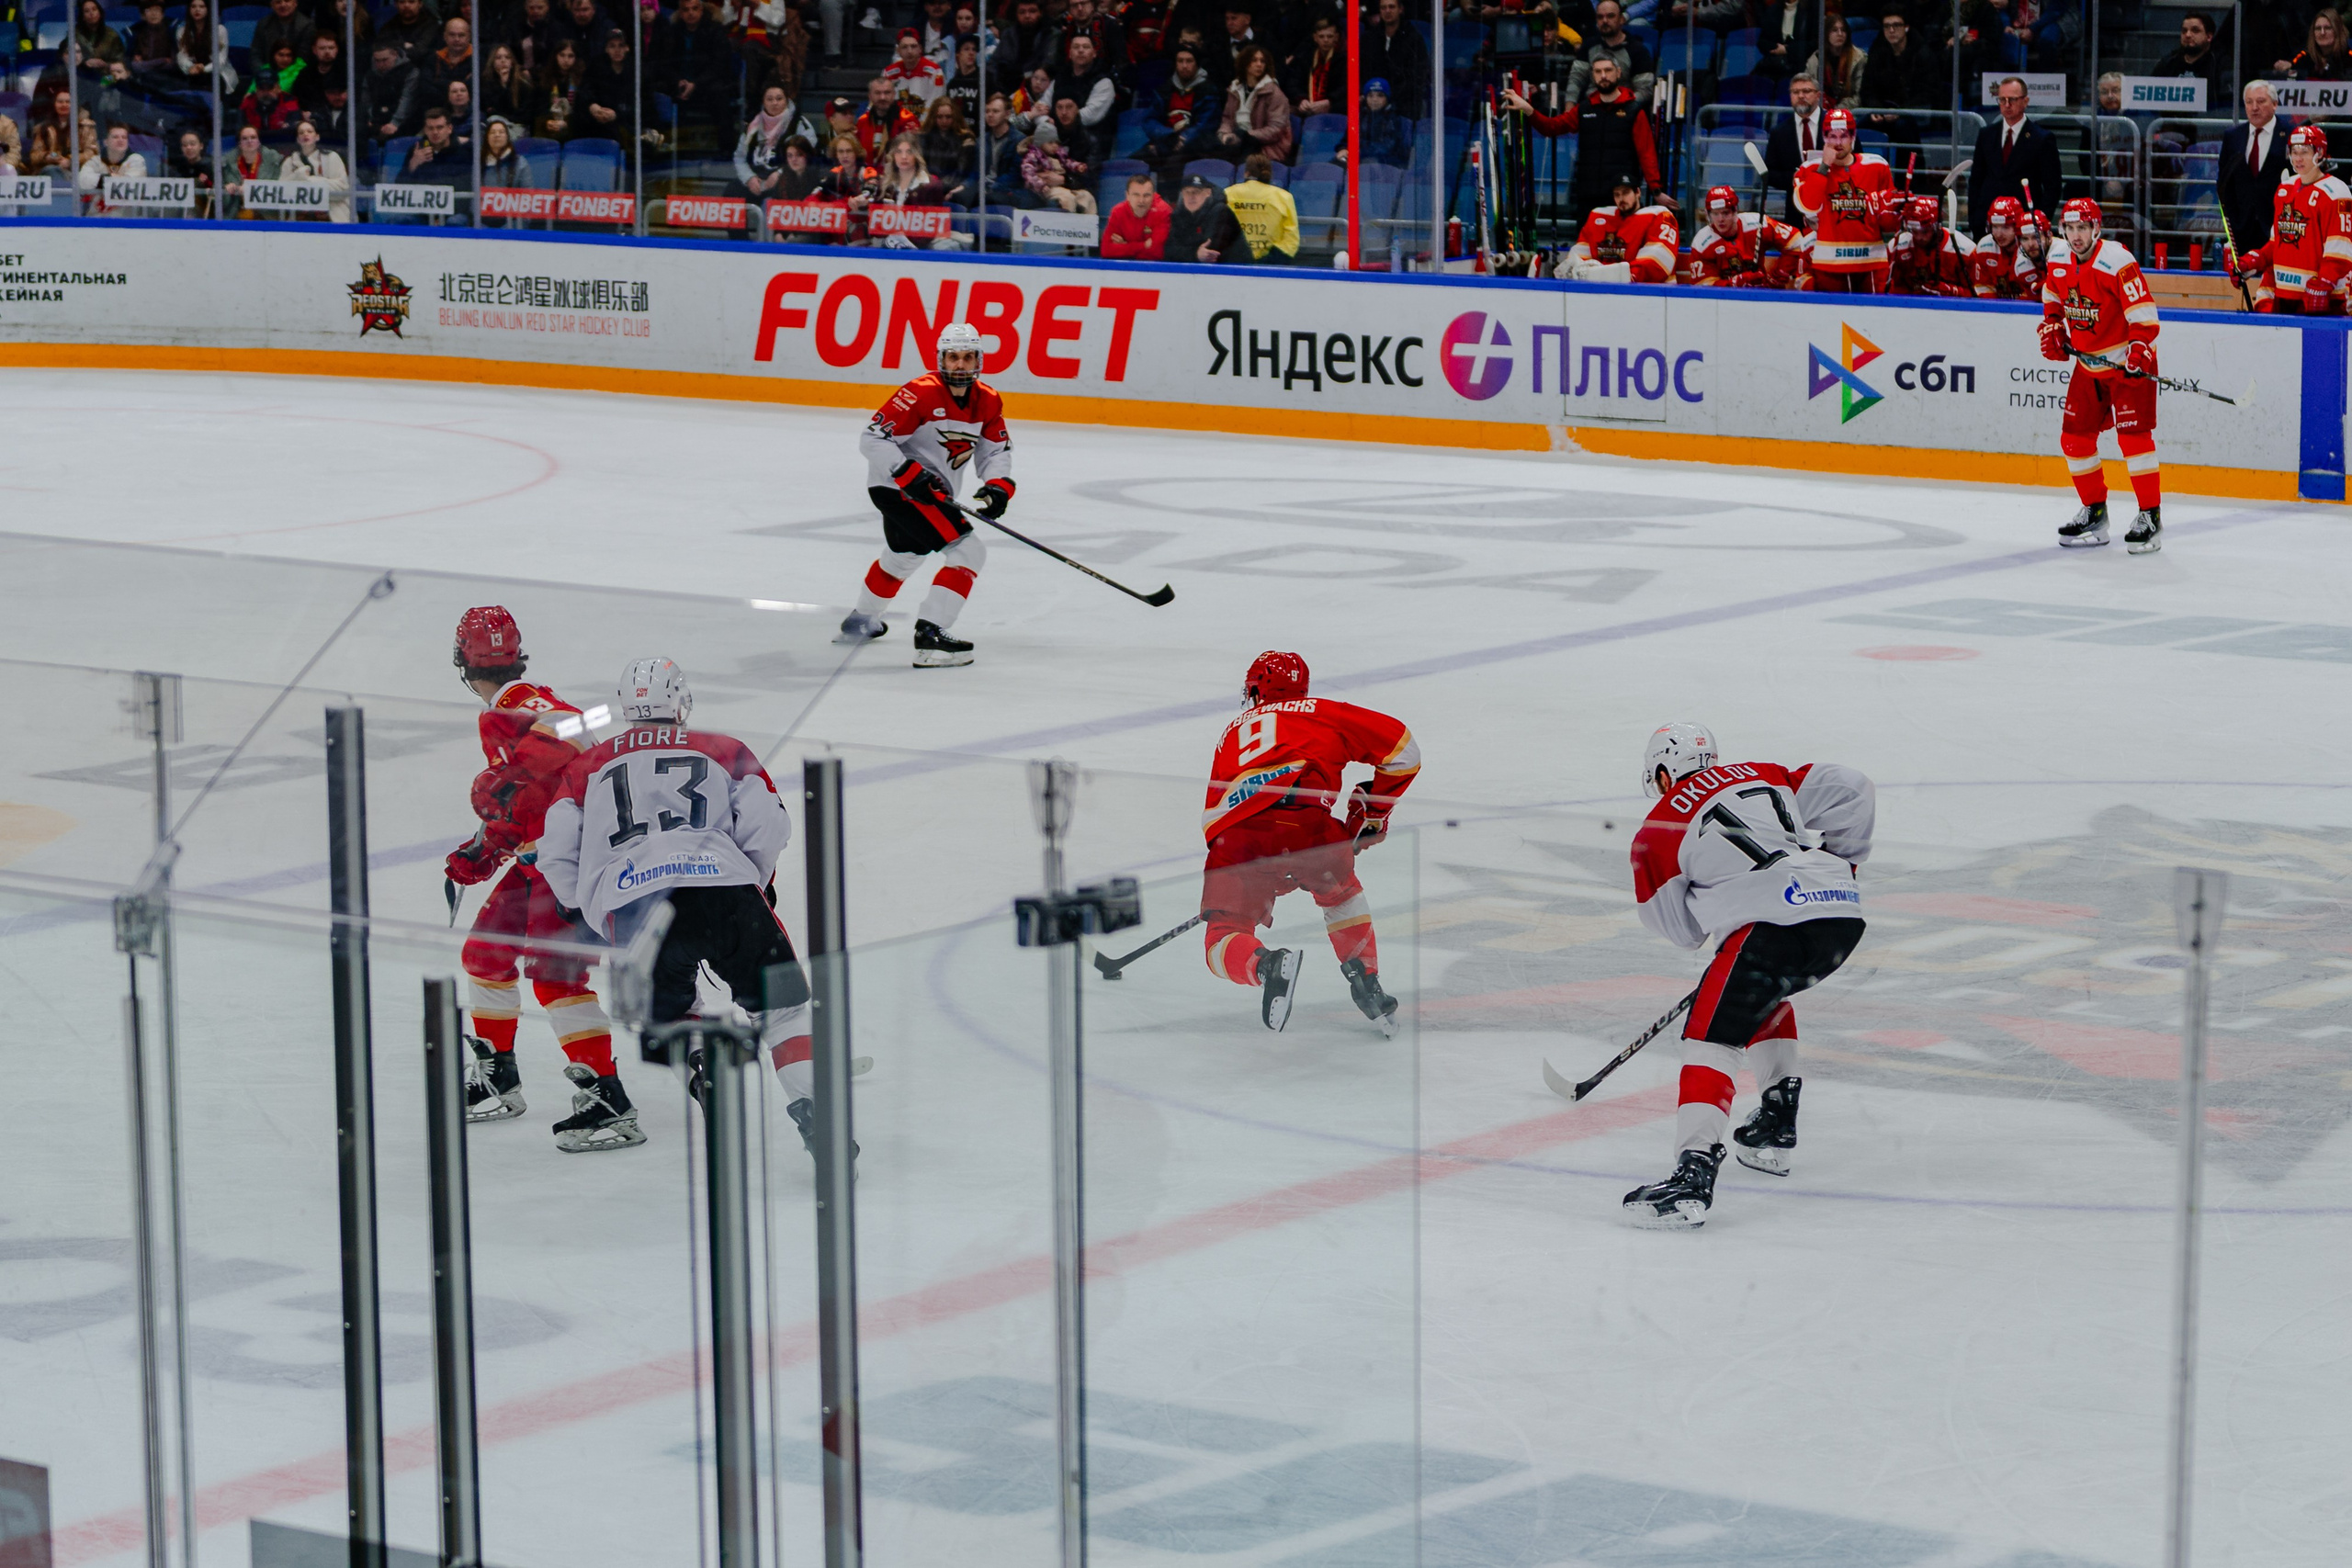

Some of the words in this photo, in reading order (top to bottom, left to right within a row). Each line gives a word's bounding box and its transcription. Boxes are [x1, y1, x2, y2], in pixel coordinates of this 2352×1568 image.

[2132, 85, 2195, 103] SIBUR
[2277, 88, 2348, 107] KHL.RU
[109, 182, 188, 201] KHL.RU
[249, 186, 323, 205] KHL.RU
[380, 189, 448, 209] KHL.RU
[2308, 190, 2319, 207] C
[482, 192, 556, 216] FONBET
[559, 195, 634, 218] FONBET
[668, 200, 744, 223] FONBET
[1234, 202, 1265, 210] SAFETY
[768, 205, 846, 228] FONBET
[870, 209, 950, 233] FONBET
[1034, 225, 1091, 240] Ростелеком
[1658, 224, 1677, 245] 29
[1835, 248, 1870, 258] SIBUR
[2123, 277, 2147, 303] 92
[439, 308, 479, 328] BEIJING
[482, 310, 522, 330] KUNLUN
[526, 312, 546, 332] RED
[550, 314, 575, 333] STAR
[579, 316, 618, 336] HOCKEY
[624, 318, 650, 337] CLUB
[754, 273, 1160, 382] FONBET
[1207, 309, 1424, 392] Яндекс
[1532, 323, 1704, 402] Плюс
[1894, 355, 1976, 394] сбп
[2009, 367, 2070, 385] систе
[2009, 392, 2067, 410] плате
[867, 412, 897, 441] 24
[2117, 420, 2138, 428] CCM
[491, 633, 503, 647] 13
[1291, 670, 1299, 682] 9
[635, 705, 651, 718] 13
[614, 726, 688, 753] FIORE
[1238, 712, 1278, 767] 9
[1699, 753, 1711, 768] 17
[1227, 766, 1291, 808] SIBUR
[1670, 764, 1758, 814] OKULOV
[599, 755, 708, 849] 13
[1699, 786, 1807, 872] 17
